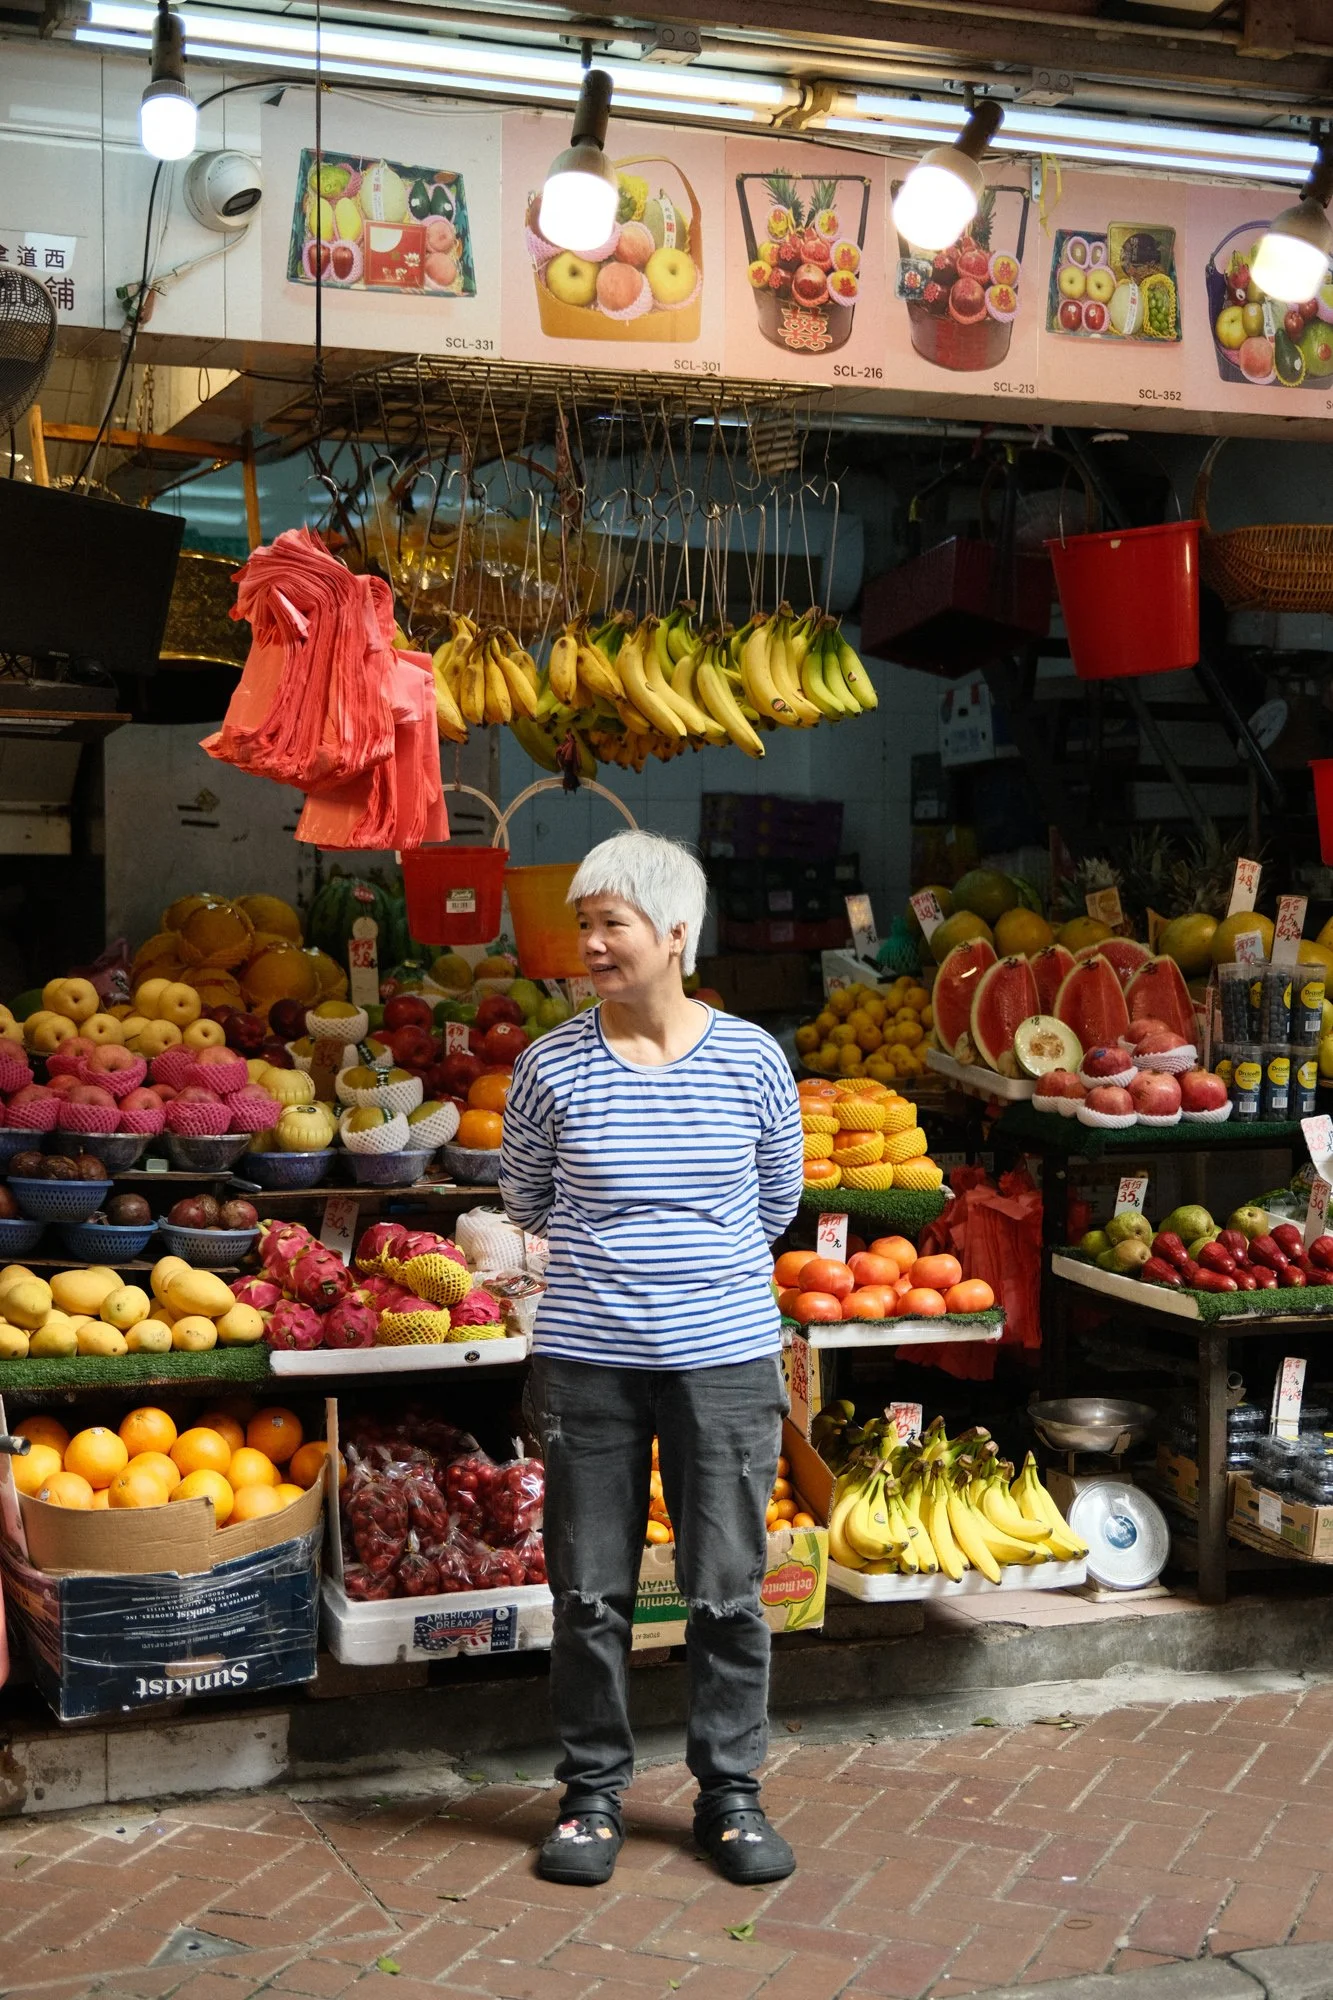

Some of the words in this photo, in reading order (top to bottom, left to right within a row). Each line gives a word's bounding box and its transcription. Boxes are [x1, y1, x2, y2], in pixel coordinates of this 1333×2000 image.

[445, 337, 494, 350] SCL-331
[674, 359, 721, 372] SCL-301
[833, 364, 883, 379] SCL-216
[993, 381, 1035, 394] SCL-213
[1138, 388, 1182, 401] SCL-352
[762, 1580, 796, 1595] Monte
[797, 1578, 813, 1592] Del
[177, 1604, 216, 1620] Sunkist
[427, 1611, 483, 1623] AMERICAN
[436, 1620, 472, 1629] DREAM
[643, 1632, 661, 1640] STORE
[136, 1662, 249, 1699] Sunkist
